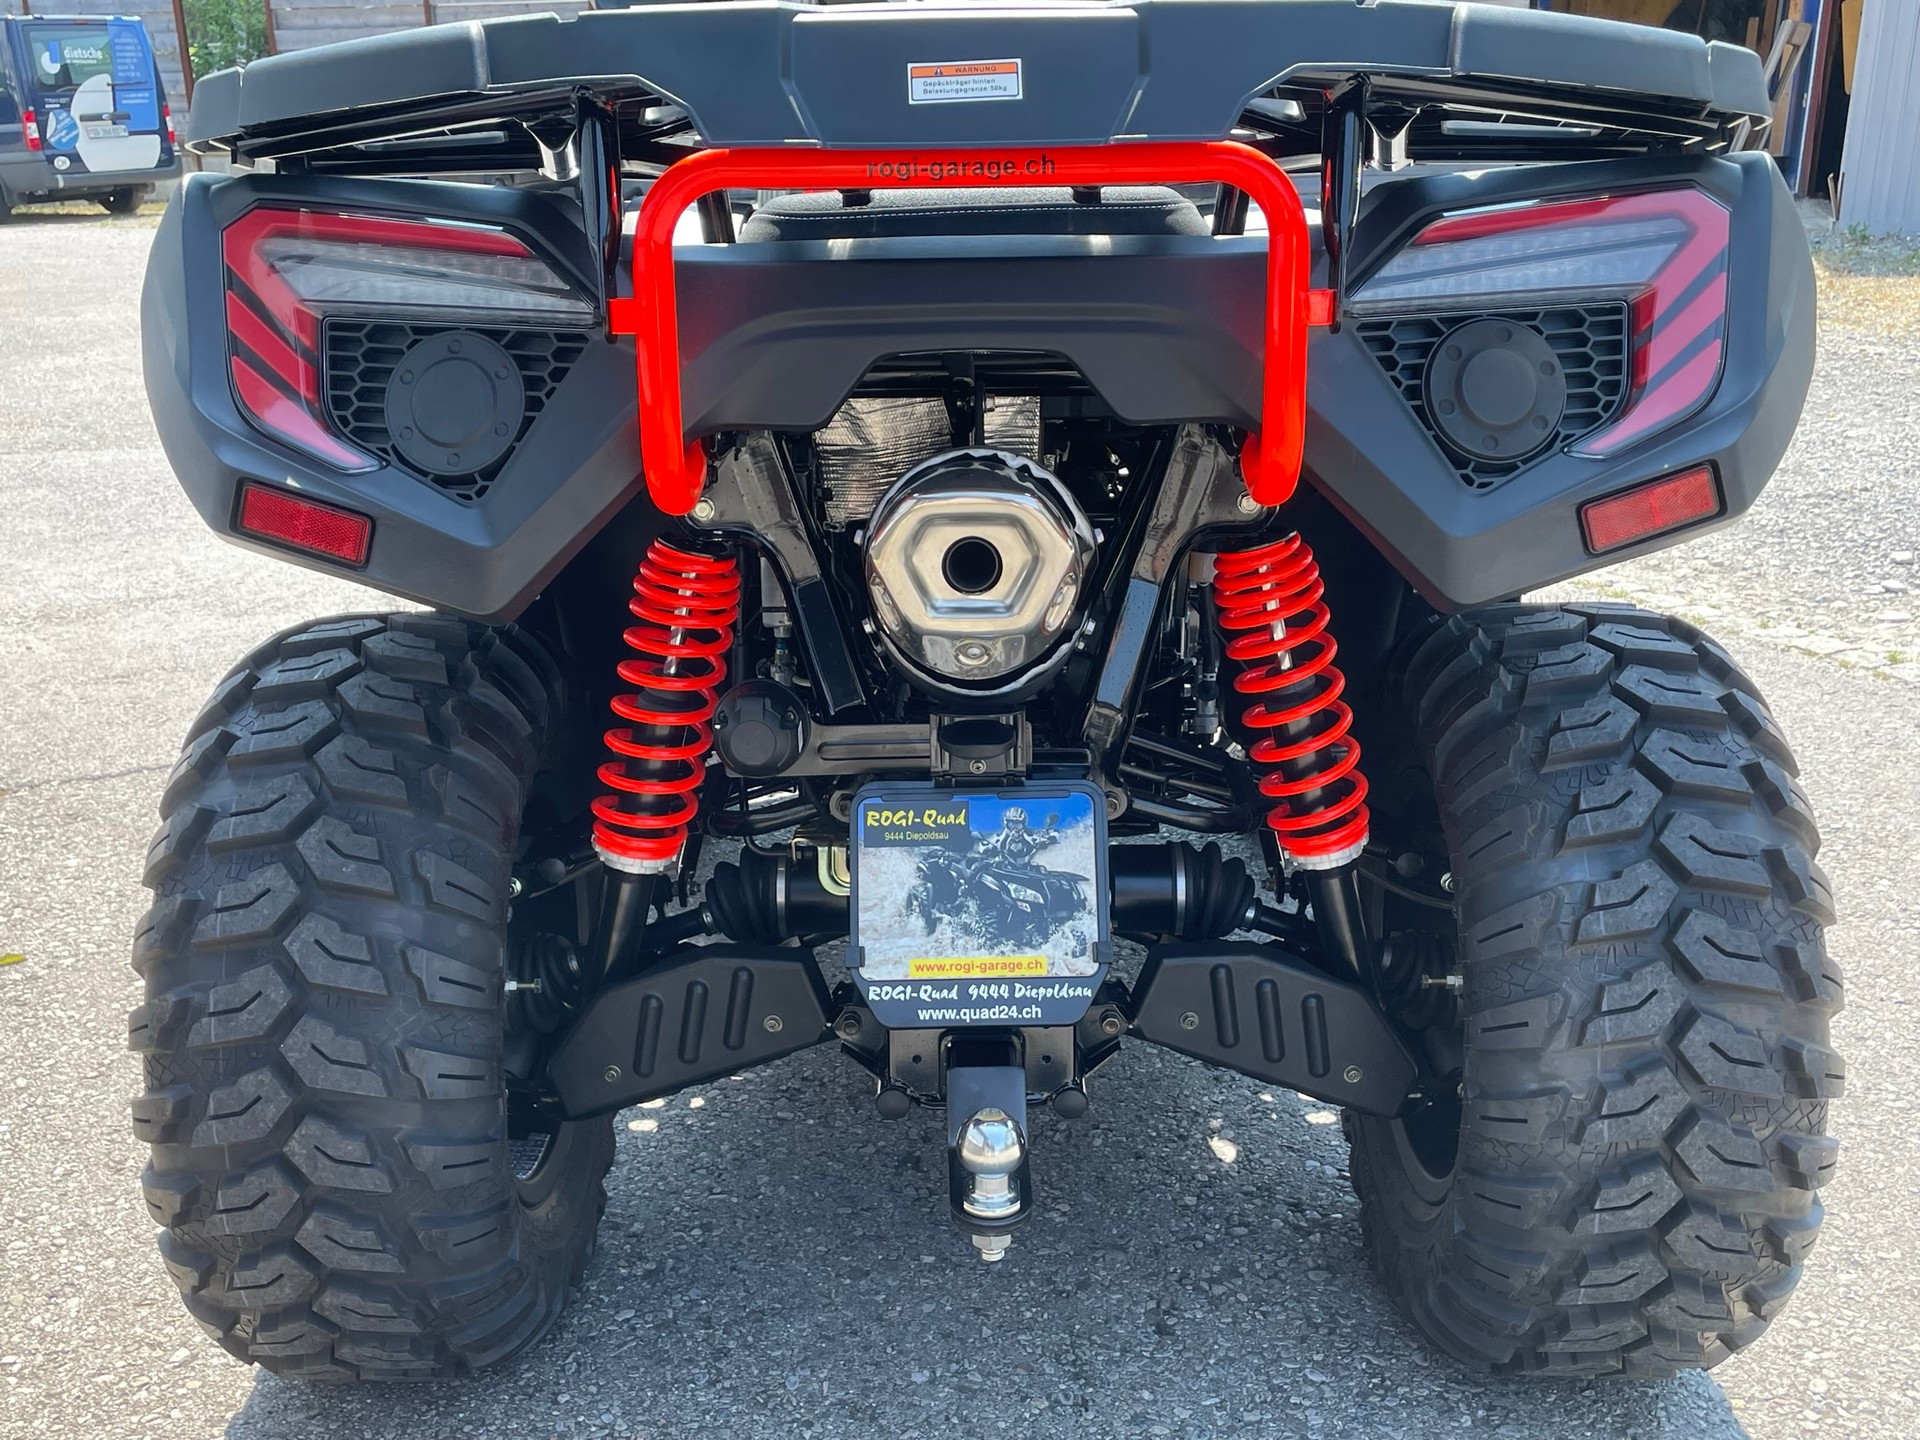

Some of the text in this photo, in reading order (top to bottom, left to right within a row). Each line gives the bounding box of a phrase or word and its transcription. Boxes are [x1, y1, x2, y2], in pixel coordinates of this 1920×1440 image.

[64, 46, 103, 59] dietsche
[954, 65, 997, 74] WARNUNG
[922, 78, 971, 88] Gepäckträger
[867, 154, 1056, 181] rogi-garage.ch
[866, 809, 966, 827] ROGI-Quad
[884, 830, 949, 842] 9444 Diepoldsau
[915, 959, 1043, 976] www.rogi-garage.ch
[868, 982, 1092, 1002] ROGI-Quad 9444 Diepoldsau
[917, 1005, 1042, 1023] www.quad24.ch
